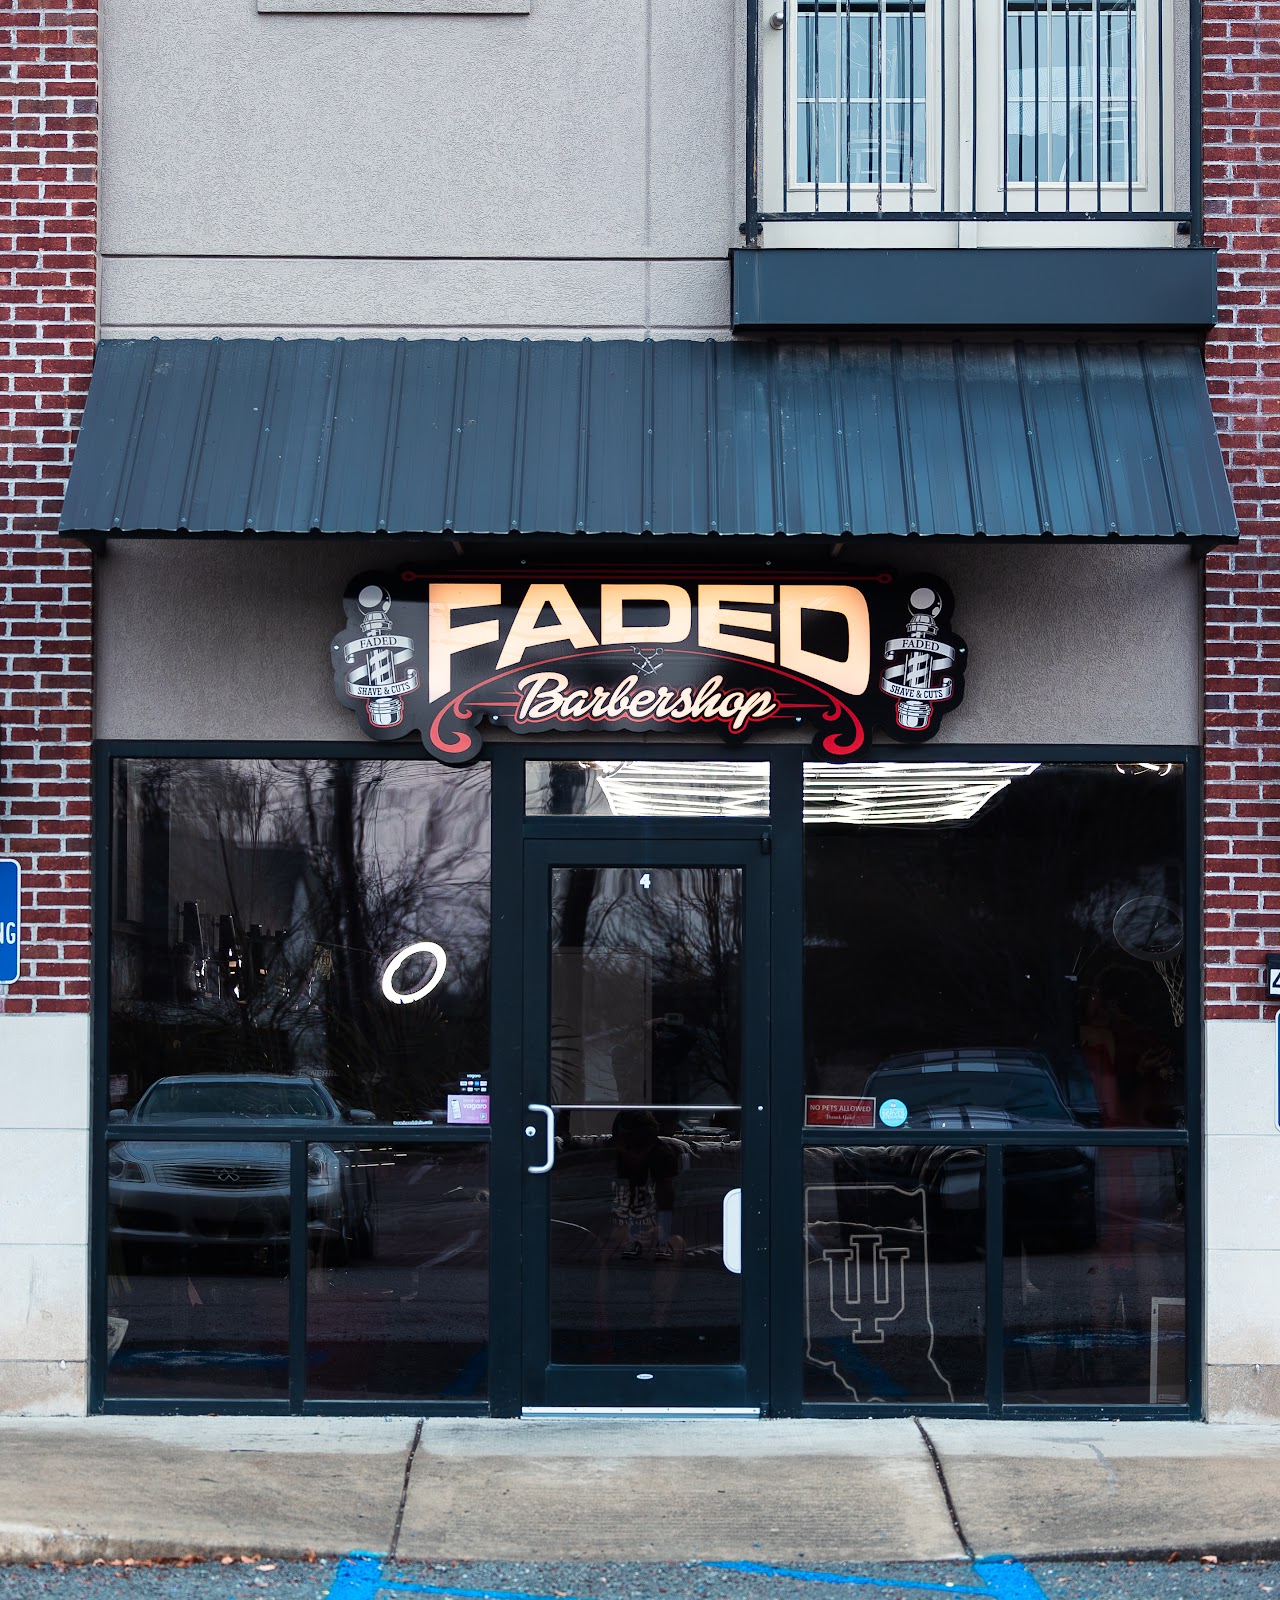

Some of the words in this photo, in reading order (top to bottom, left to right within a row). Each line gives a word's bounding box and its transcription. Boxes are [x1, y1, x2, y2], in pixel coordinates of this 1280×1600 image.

[360, 637, 397, 648] FADED
[429, 584, 870, 704] FADED
[902, 640, 940, 651] FADED
[358, 687, 382, 696] SHAVE
[384, 687, 390, 695] &
[391, 682, 411, 694] CUTS
[890, 685, 914, 697] SHAVE
[916, 690, 922, 699] &
[924, 690, 943, 698] CUTS
[517, 672, 778, 730] Barbershop
[640, 874, 651, 888] 4
